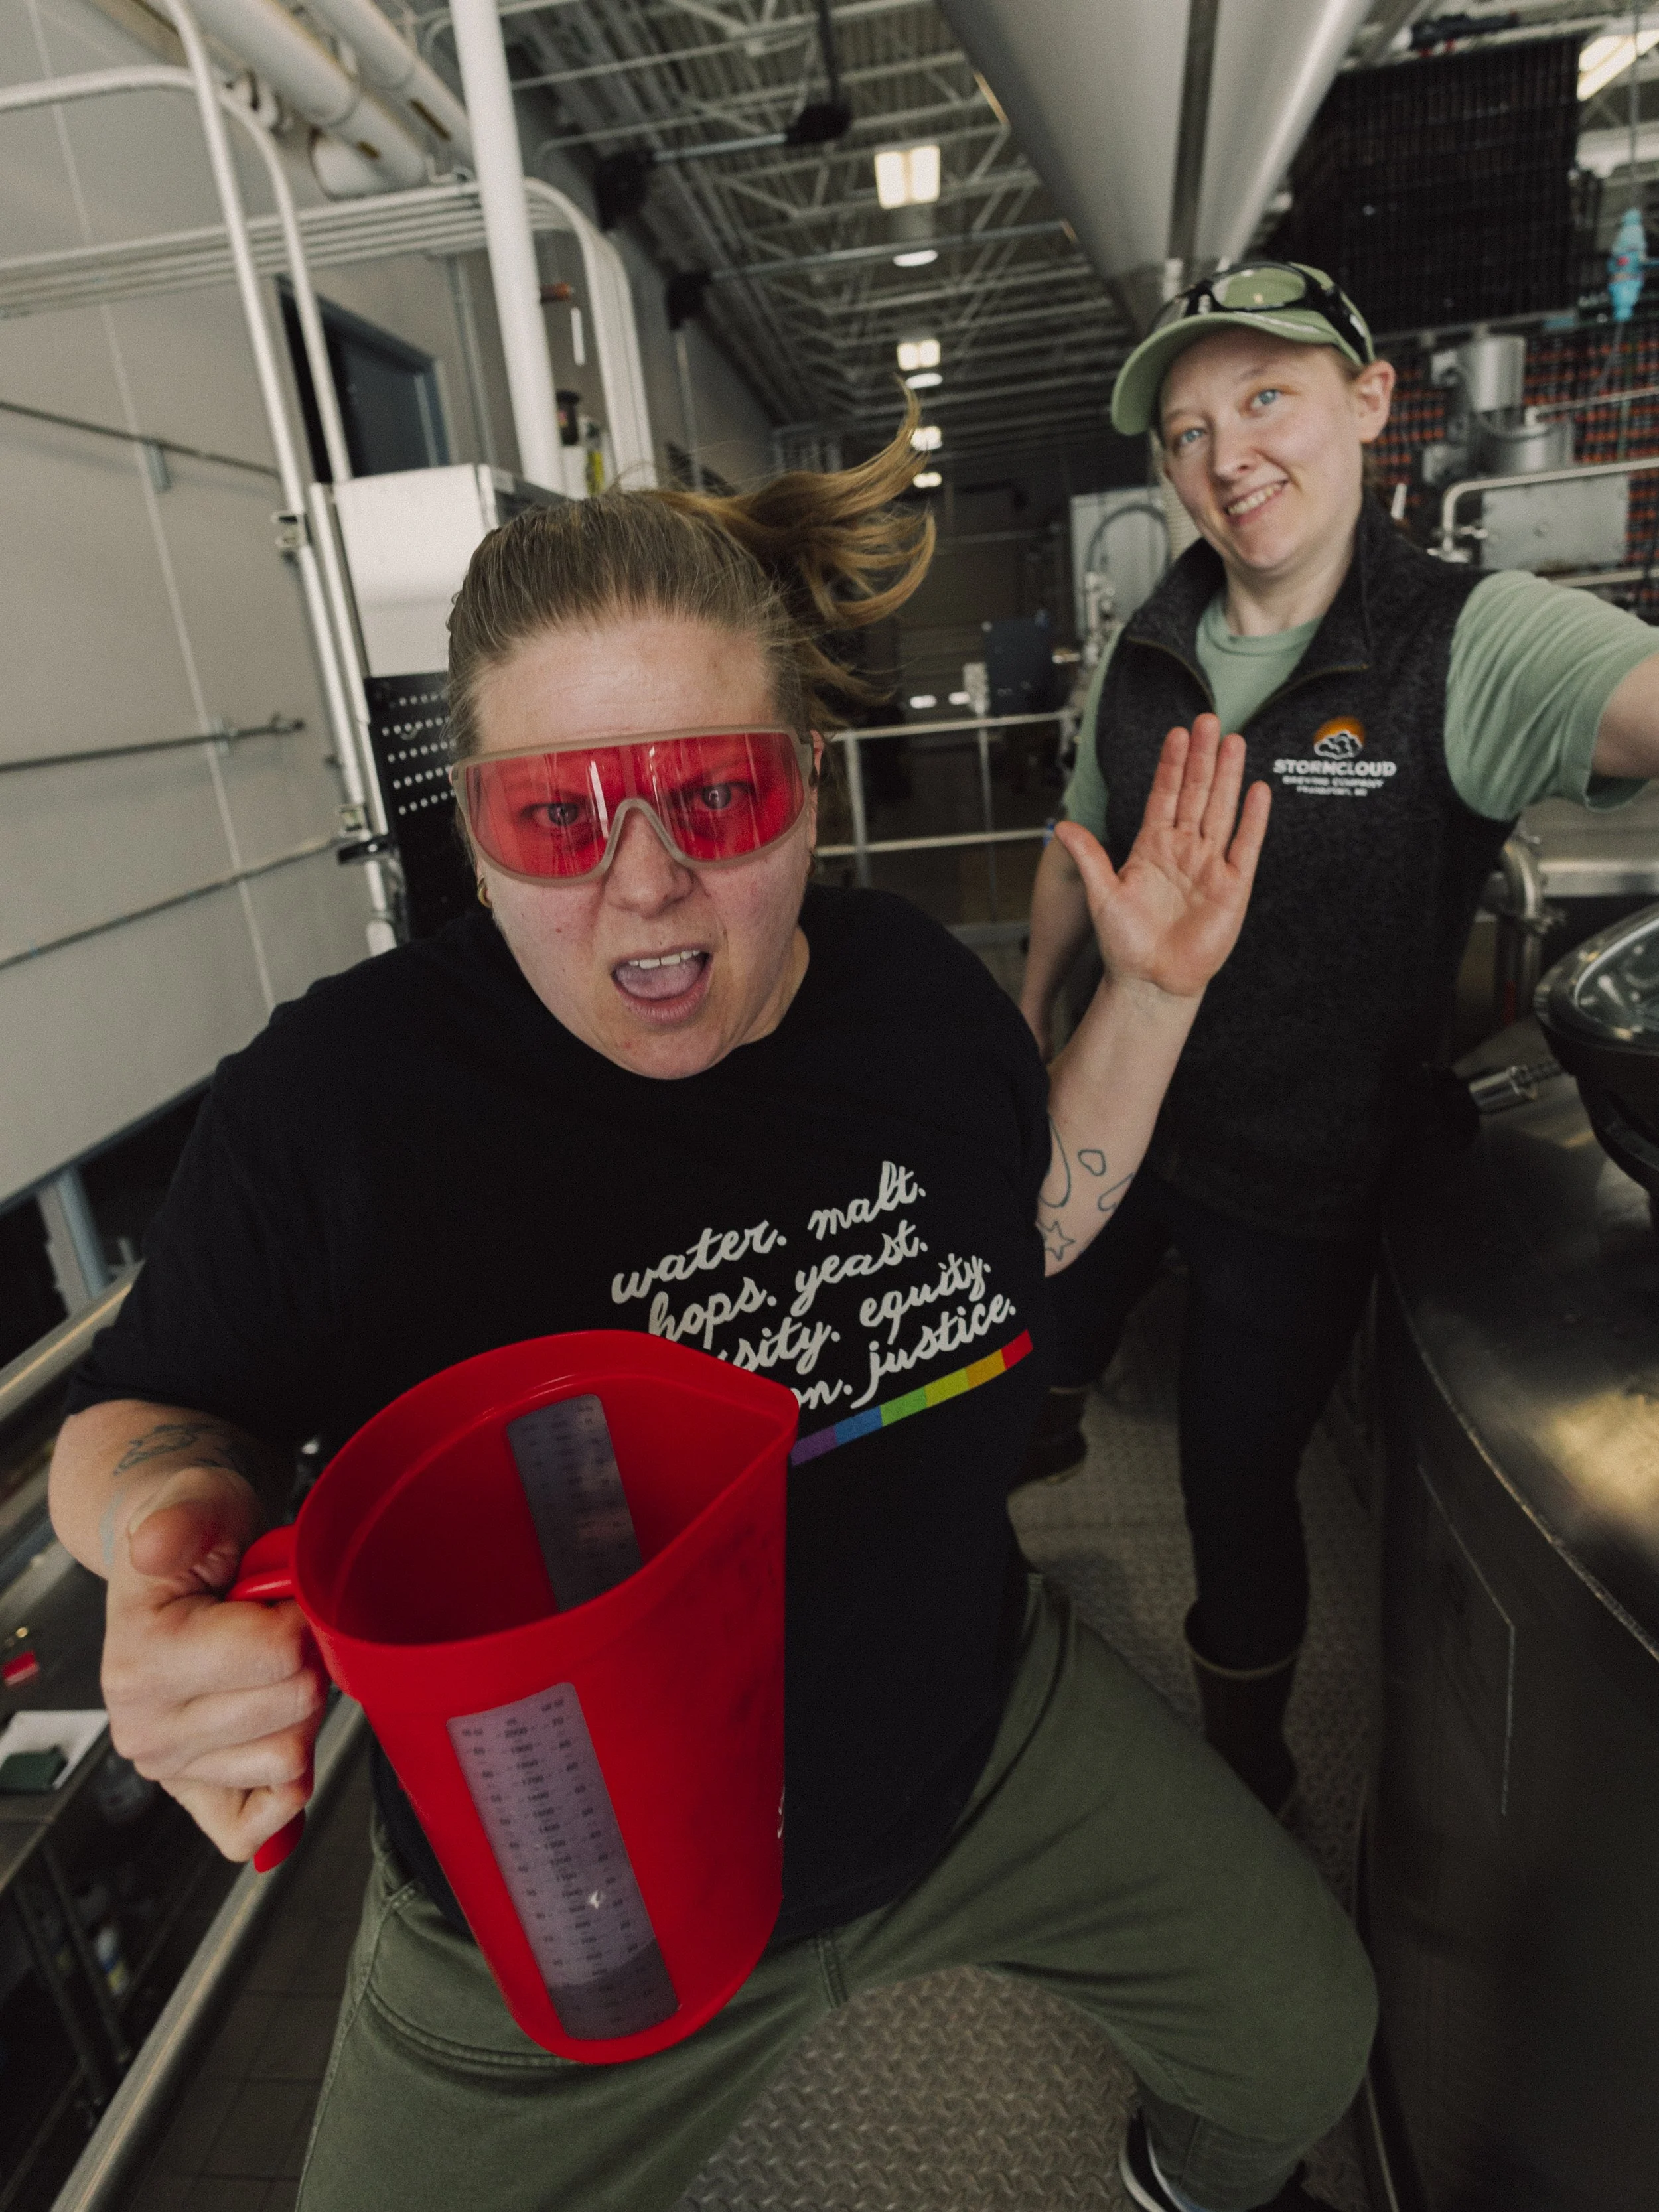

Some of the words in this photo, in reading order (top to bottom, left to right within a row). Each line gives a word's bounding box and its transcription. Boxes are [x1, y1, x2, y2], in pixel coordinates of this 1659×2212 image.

[1273, 758, 1397, 777] STORMCLOUD
[611, 1220, 787, 1304] water.
[807, 1161, 926, 1240] malt.
[648, 1277, 777, 1350] hops.
[790, 1220, 928, 1317] yeast.
[717, 1317, 841, 1375] sity.
[859, 1253, 991, 1345] equity.
[850, 1294, 1017, 1409] justice.
